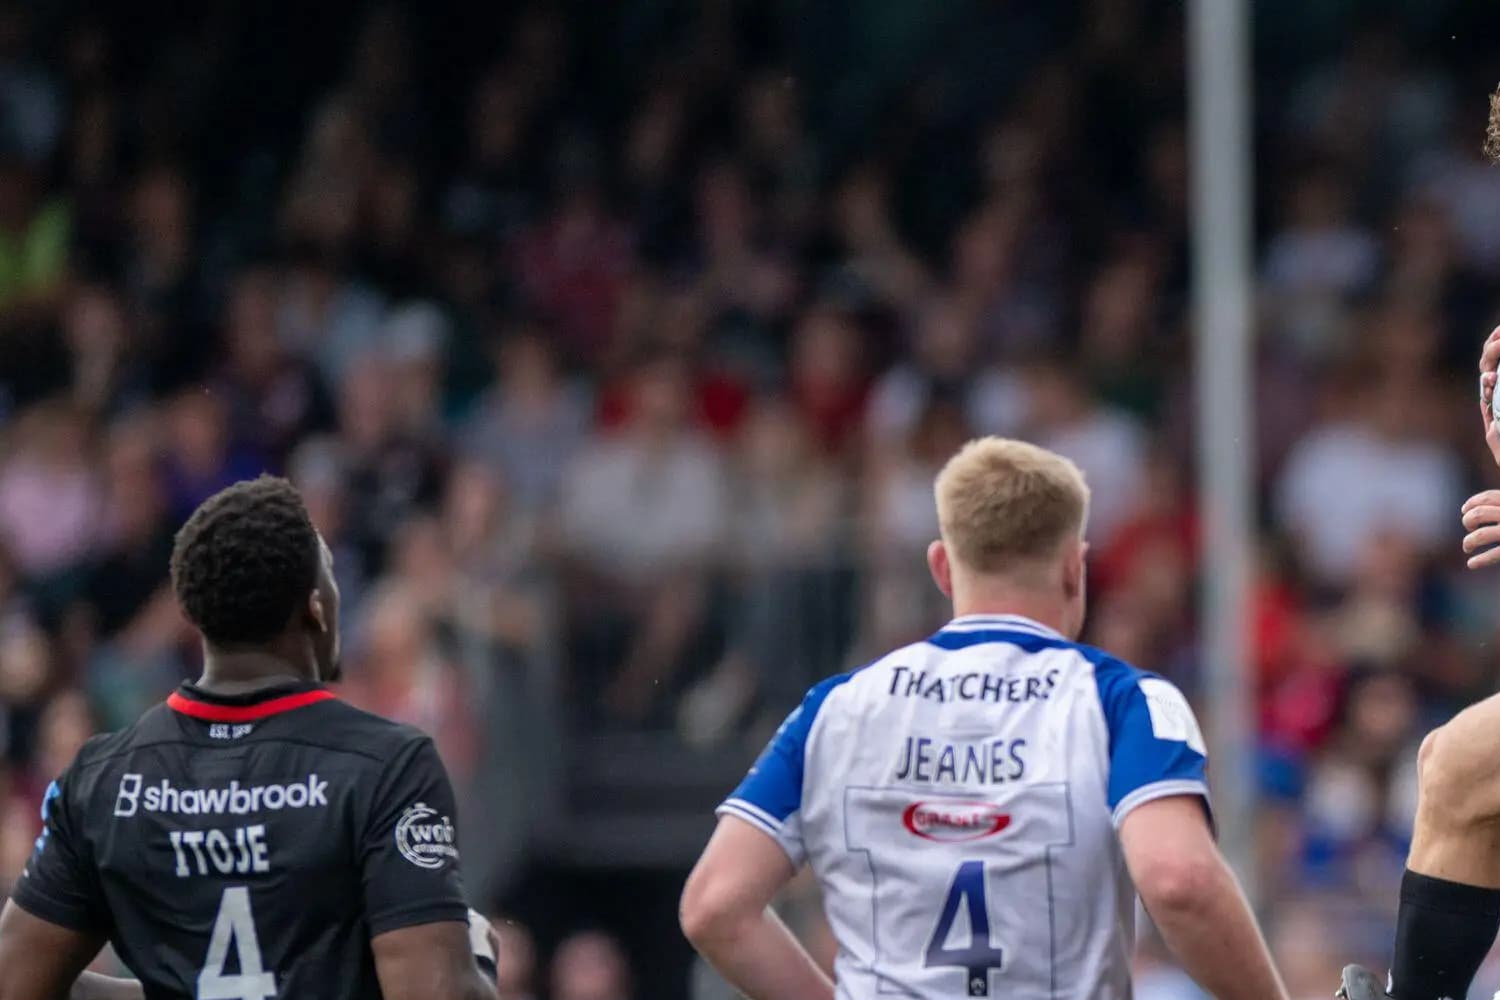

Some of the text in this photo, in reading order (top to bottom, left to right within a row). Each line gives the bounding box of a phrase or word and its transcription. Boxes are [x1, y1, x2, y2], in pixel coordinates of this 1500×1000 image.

[888, 666, 1060, 703] THATCHERS
[895, 735, 1027, 785] JEANES
[143, 773, 328, 815] shawbrook
[169, 824, 270, 878] ITOJE
[922, 859, 1004, 997] 4
